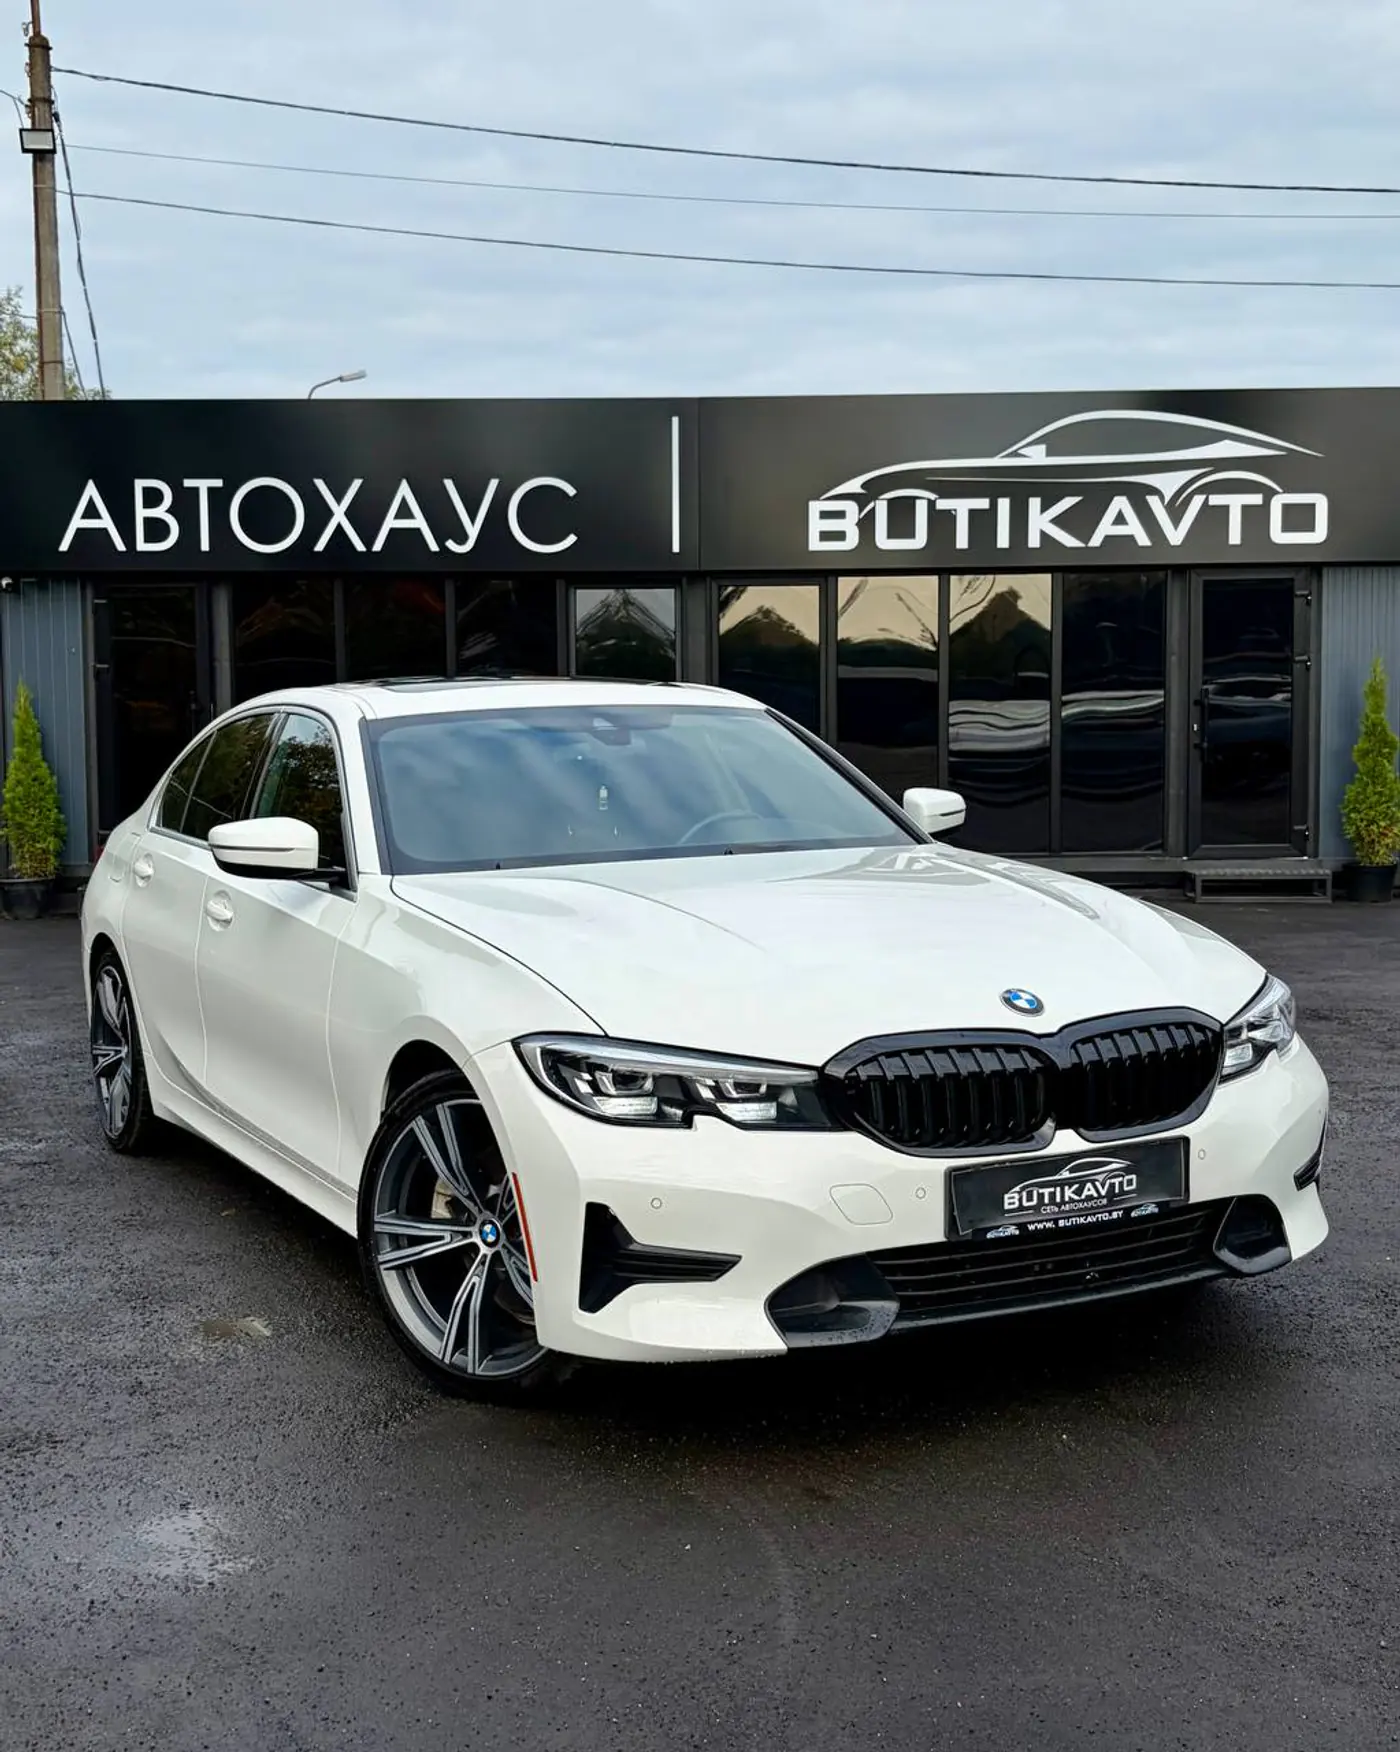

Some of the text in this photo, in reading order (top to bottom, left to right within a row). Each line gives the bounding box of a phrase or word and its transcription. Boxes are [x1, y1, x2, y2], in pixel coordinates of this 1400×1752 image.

[58, 476, 578, 554] АВТОХАУС
[807, 492, 1329, 552] BUTIKAVTO
[1003, 1173, 1137, 1210] BUTIKAVTO
[1058, 1210, 1124, 1228] BUTIKAVTO.BY
